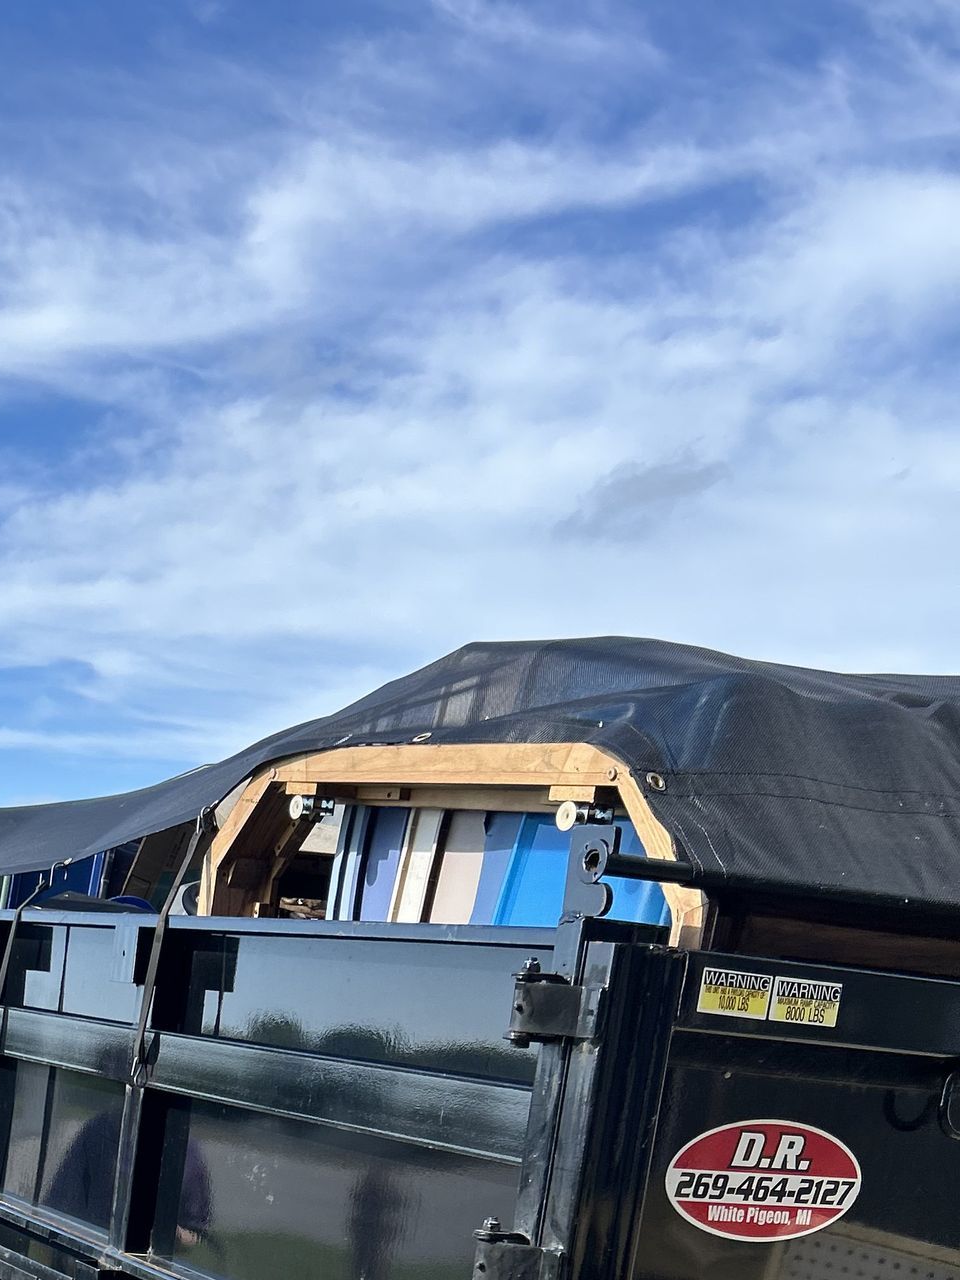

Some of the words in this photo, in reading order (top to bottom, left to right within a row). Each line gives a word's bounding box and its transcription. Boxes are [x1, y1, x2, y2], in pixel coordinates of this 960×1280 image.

[705, 972, 770, 991] WARNING
[778, 981, 841, 1002] WARNING
[718, 995, 736, 1011] 10,000
[737, 996, 749, 1012] LBS
[777, 997, 799, 1006] MAXIMUM
[785, 1006, 805, 1021] 8000
[808, 1008, 825, 1023] LBS
[730, 1131, 811, 1171] D.R.
[674, 1172, 856, 1206] 269-464-2127
[707, 1205, 744, 1223] White
[746, 1207, 792, 1226] Pigeon,
[795, 1209, 813, 1226] MI
